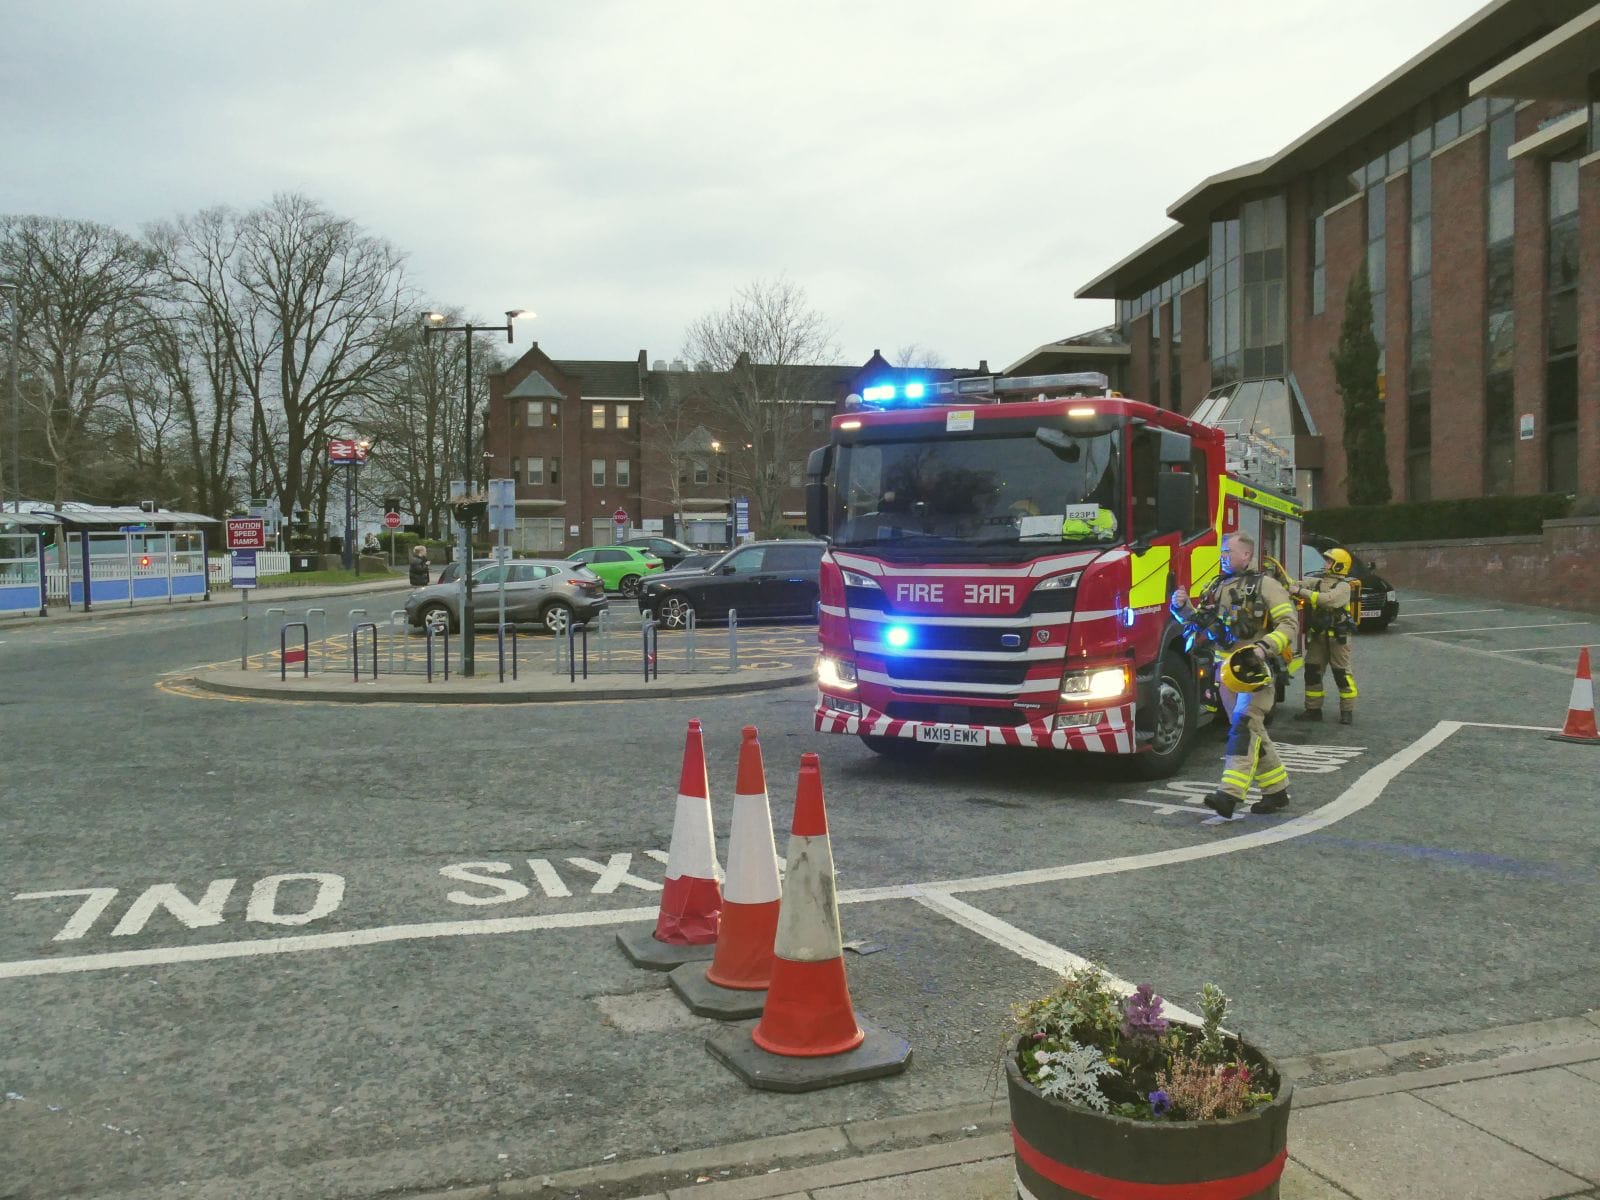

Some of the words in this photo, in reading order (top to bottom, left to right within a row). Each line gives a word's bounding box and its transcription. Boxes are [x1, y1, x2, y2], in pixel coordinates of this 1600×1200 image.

[896, 583, 944, 603] FIRE
[923, 726, 951, 742] MX19
[953, 728, 979, 743] EWK
[12, 872, 346, 941] ONL
